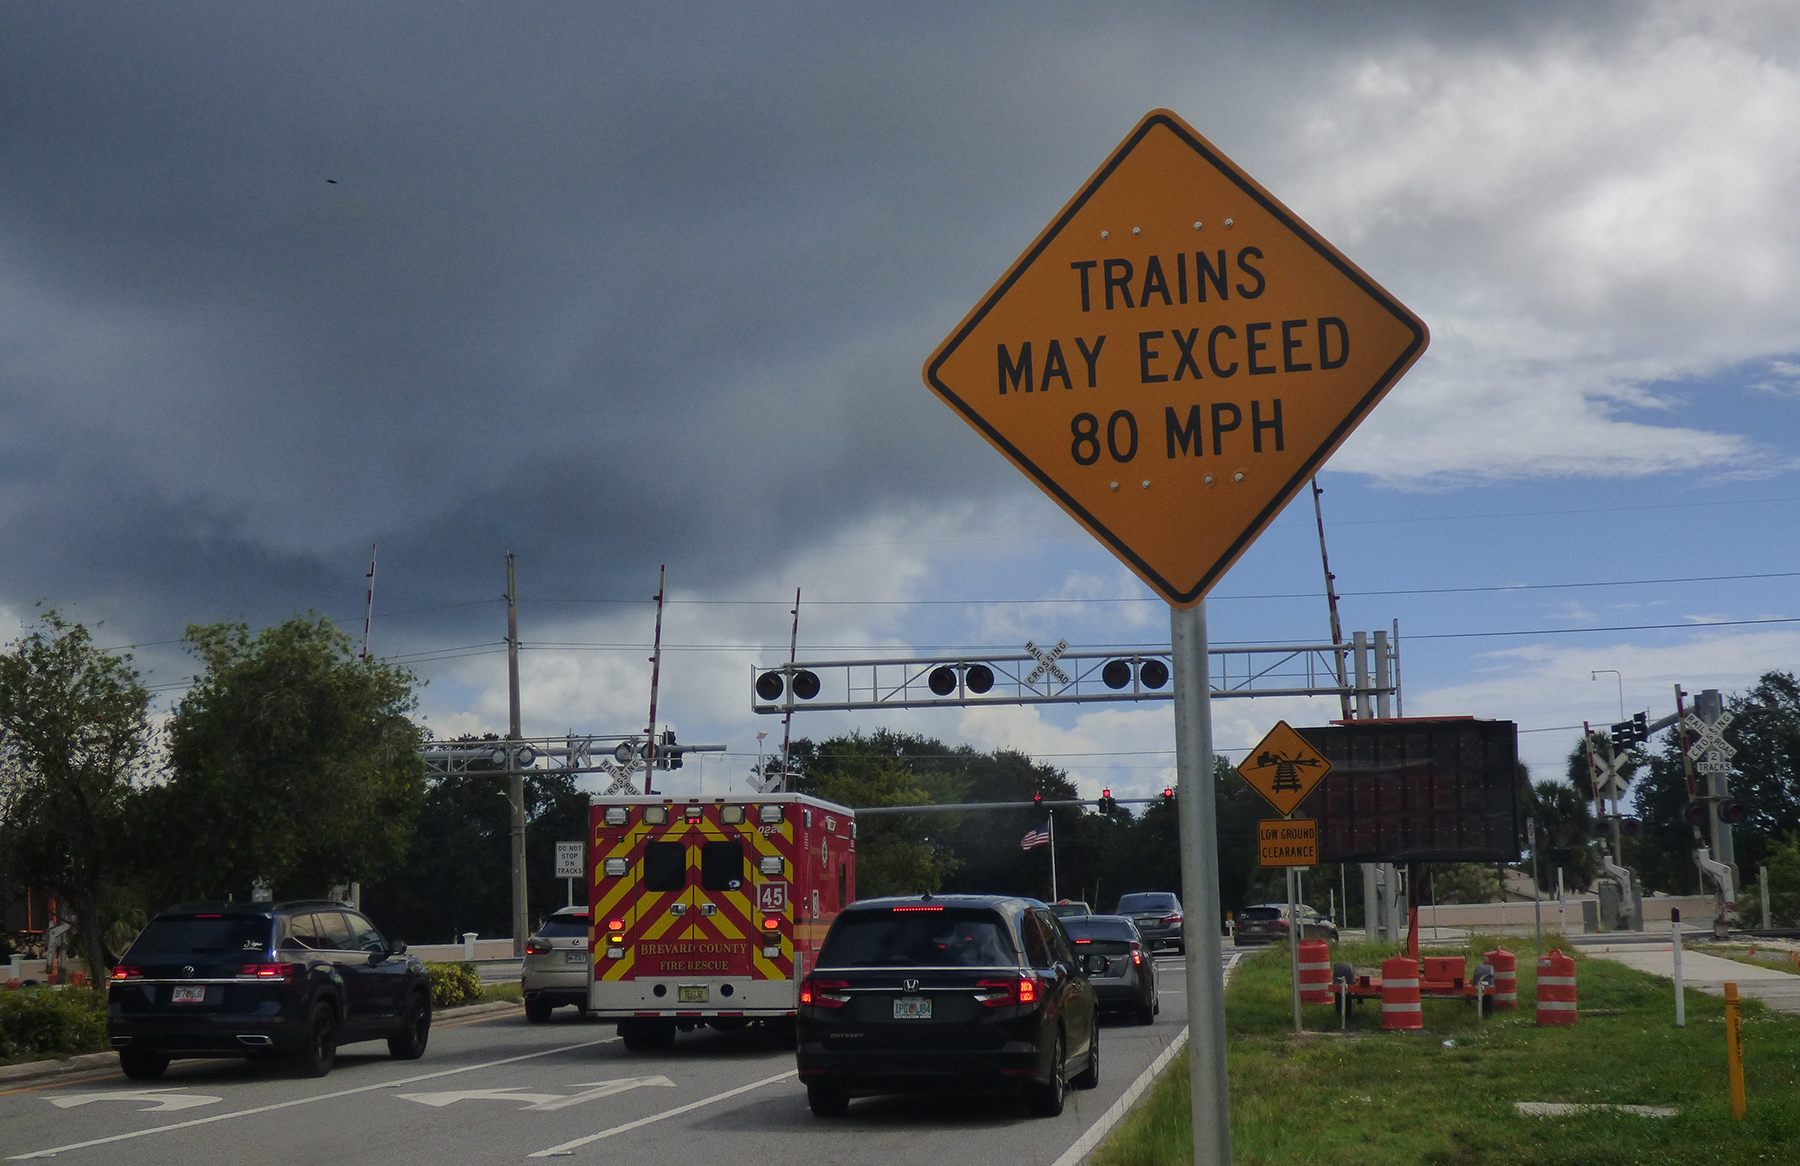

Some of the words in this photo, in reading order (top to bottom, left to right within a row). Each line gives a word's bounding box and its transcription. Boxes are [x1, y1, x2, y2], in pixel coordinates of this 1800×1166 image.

[1070, 246, 1267, 312] TRAINS
[997, 335, 1107, 395] MAY
[1138, 316, 1350, 384] EXCEED
[1070, 408, 1139, 466] 80
[1165, 398, 1285, 459] MPH
[1025, 642, 1042, 661] RAIL
[1027, 642, 1066, 684] CROSSING
[1050, 665, 1069, 684] ROAD
[1686, 715, 1705, 734] RAIL
[1691, 715, 1730, 757] CROSSING
[1711, 752, 1717, 760] 2
[1713, 738, 1735, 757] ROAD
[601, 760, 617, 778] RAIL
[1699, 763, 1730, 771] TRACKS
[604, 760, 639, 795] ROSSING
[623, 782, 641, 795] ROA
[1260, 829, 1278, 840] LOW
[1281, 828, 1315, 840] GROUND
[1262, 846, 1315, 858] CLEARANCE
[762, 888, 783, 906] 45
[640, 944, 696, 955] BREVARD
[699, 943, 748, 954] COUNTY
[660, 961, 685, 971] FIRE
[687, 960, 729, 971] RESCUE
